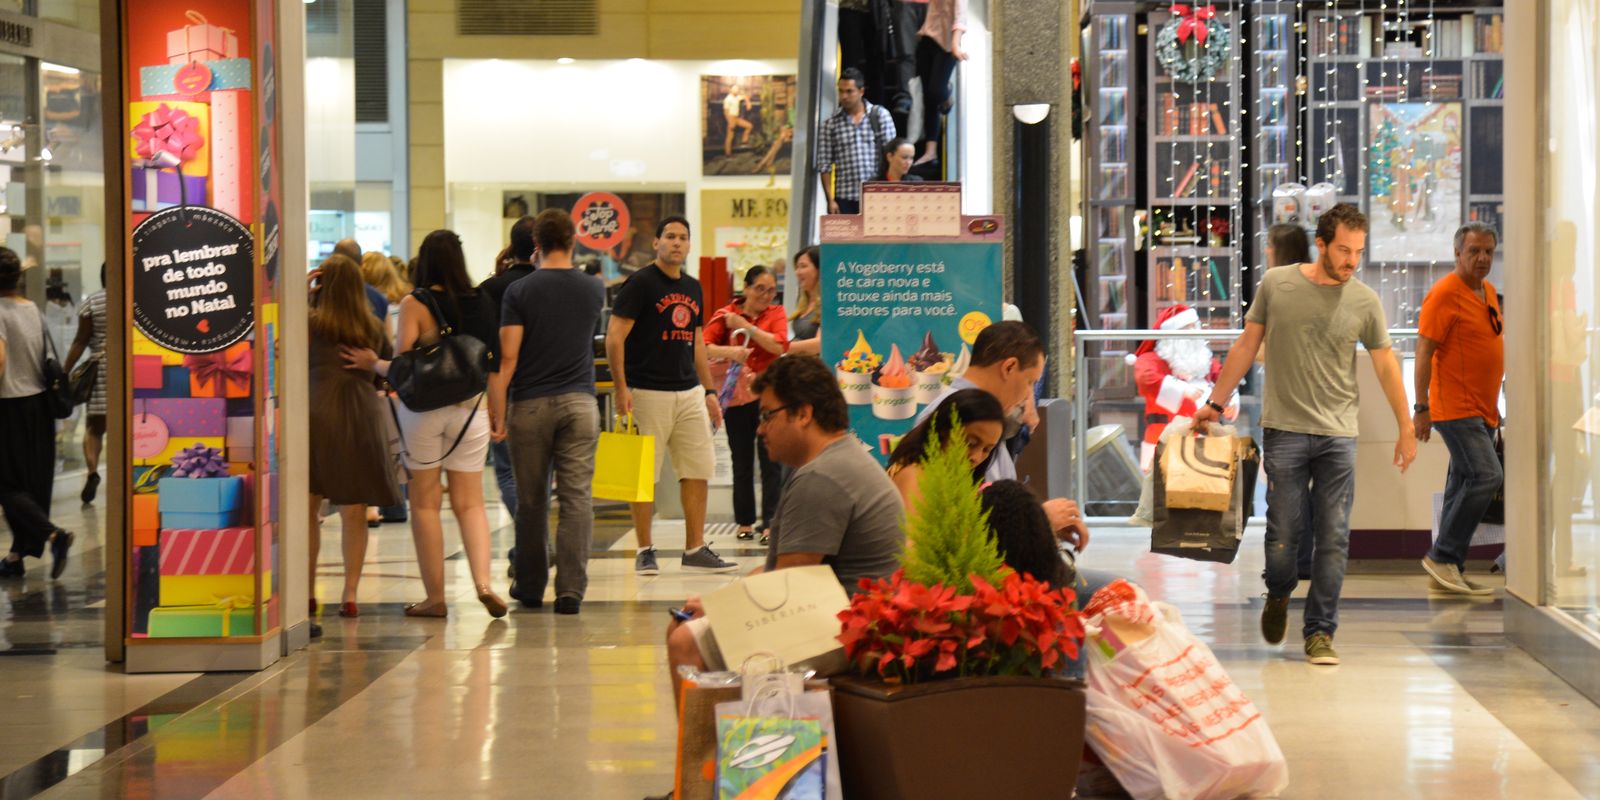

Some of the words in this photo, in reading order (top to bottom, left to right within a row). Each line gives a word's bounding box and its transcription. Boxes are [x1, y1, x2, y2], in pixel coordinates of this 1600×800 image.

[142, 253, 173, 272] pra
[172, 243, 239, 264] lembrar
[162, 267, 185, 283] de
[186, 262, 226, 279] todo
[836, 262, 846, 273] A
[848, 261, 915, 276] Yogoberry
[916, 261, 945, 273] está
[166, 279, 228, 300] mundo
[837, 276, 854, 288] de
[856, 278, 885, 288] cara
[888, 278, 919, 288] nova
[922, 278, 931, 288] e
[837, 292, 879, 302] trouxe
[882, 290, 918, 301] ainda
[920, 290, 953, 301] mais
[164, 305, 189, 319] no
[191, 295, 236, 315] Natal
[837, 304, 889, 316] sabores
[892, 307, 922, 319] para
[924, 303, 958, 316] você.
